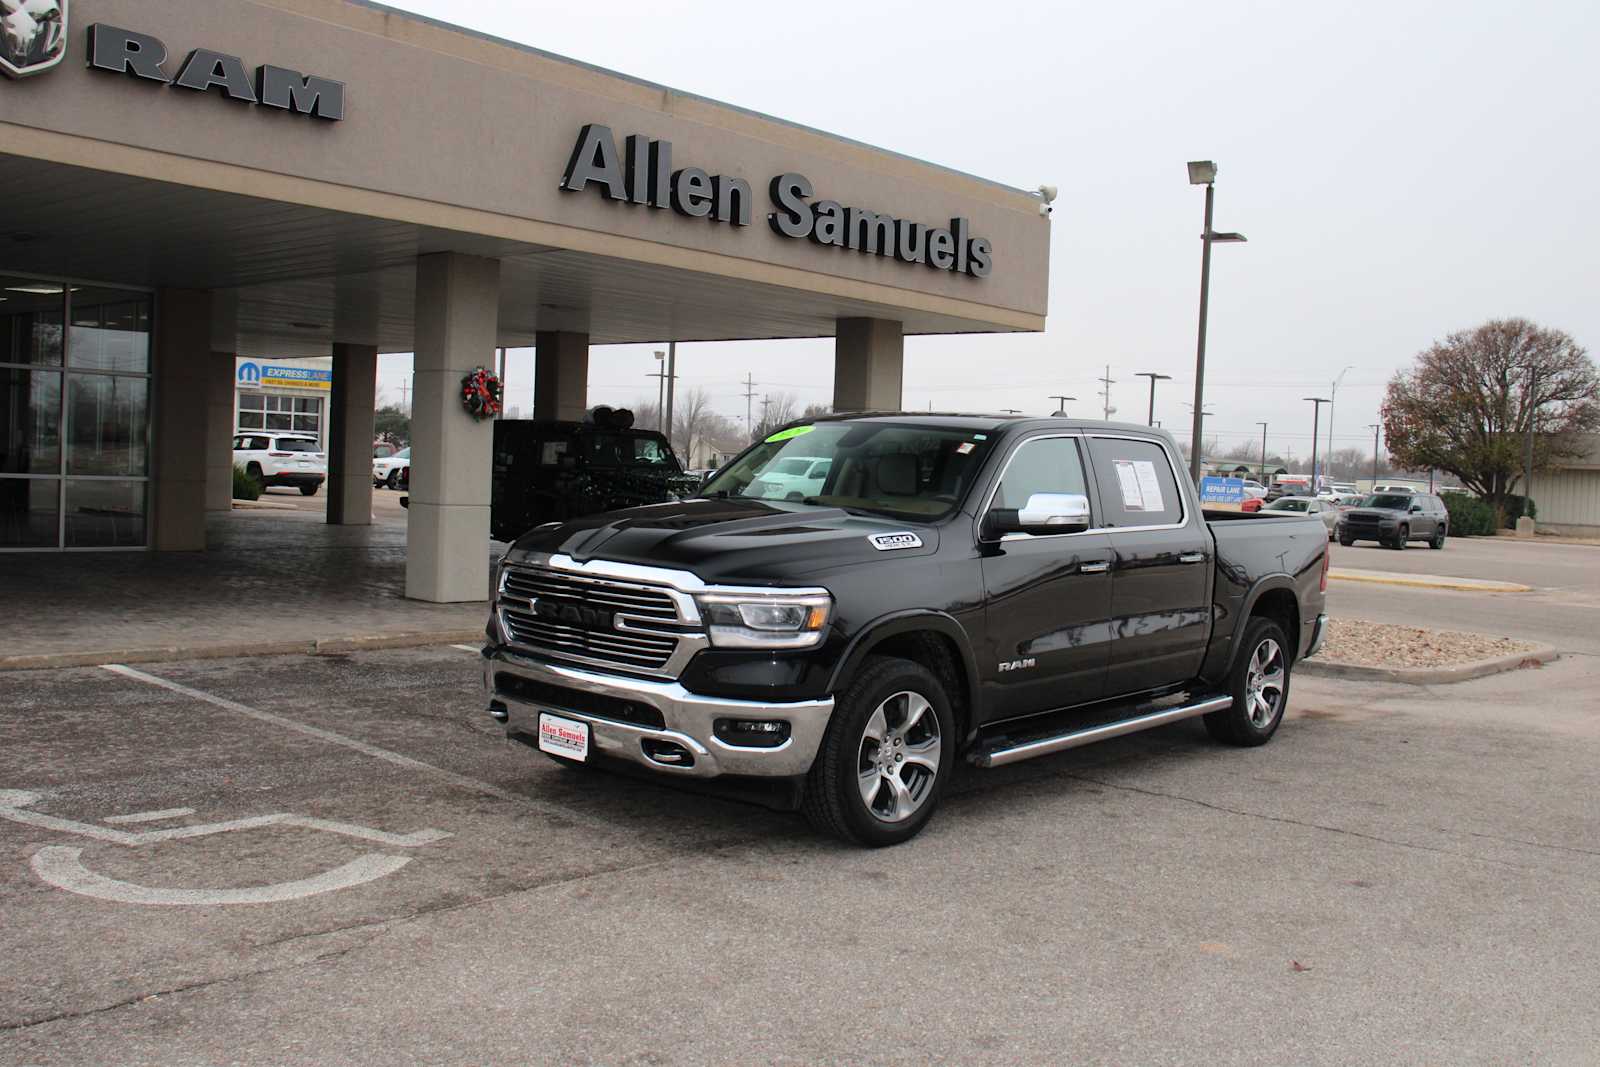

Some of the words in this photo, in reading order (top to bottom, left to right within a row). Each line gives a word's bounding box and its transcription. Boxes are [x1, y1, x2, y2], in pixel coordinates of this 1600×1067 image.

[86, 23, 344, 121] RAM
[559, 124, 752, 227] Allen
[768, 172, 993, 278] Samuels
[877, 535, 915, 544] 1500
[538, 601, 610, 628] RAM
[998, 658, 1036, 672] RAM
[542, 724, 556, 734] Allen
[558, 728, 585, 742] Samuels
